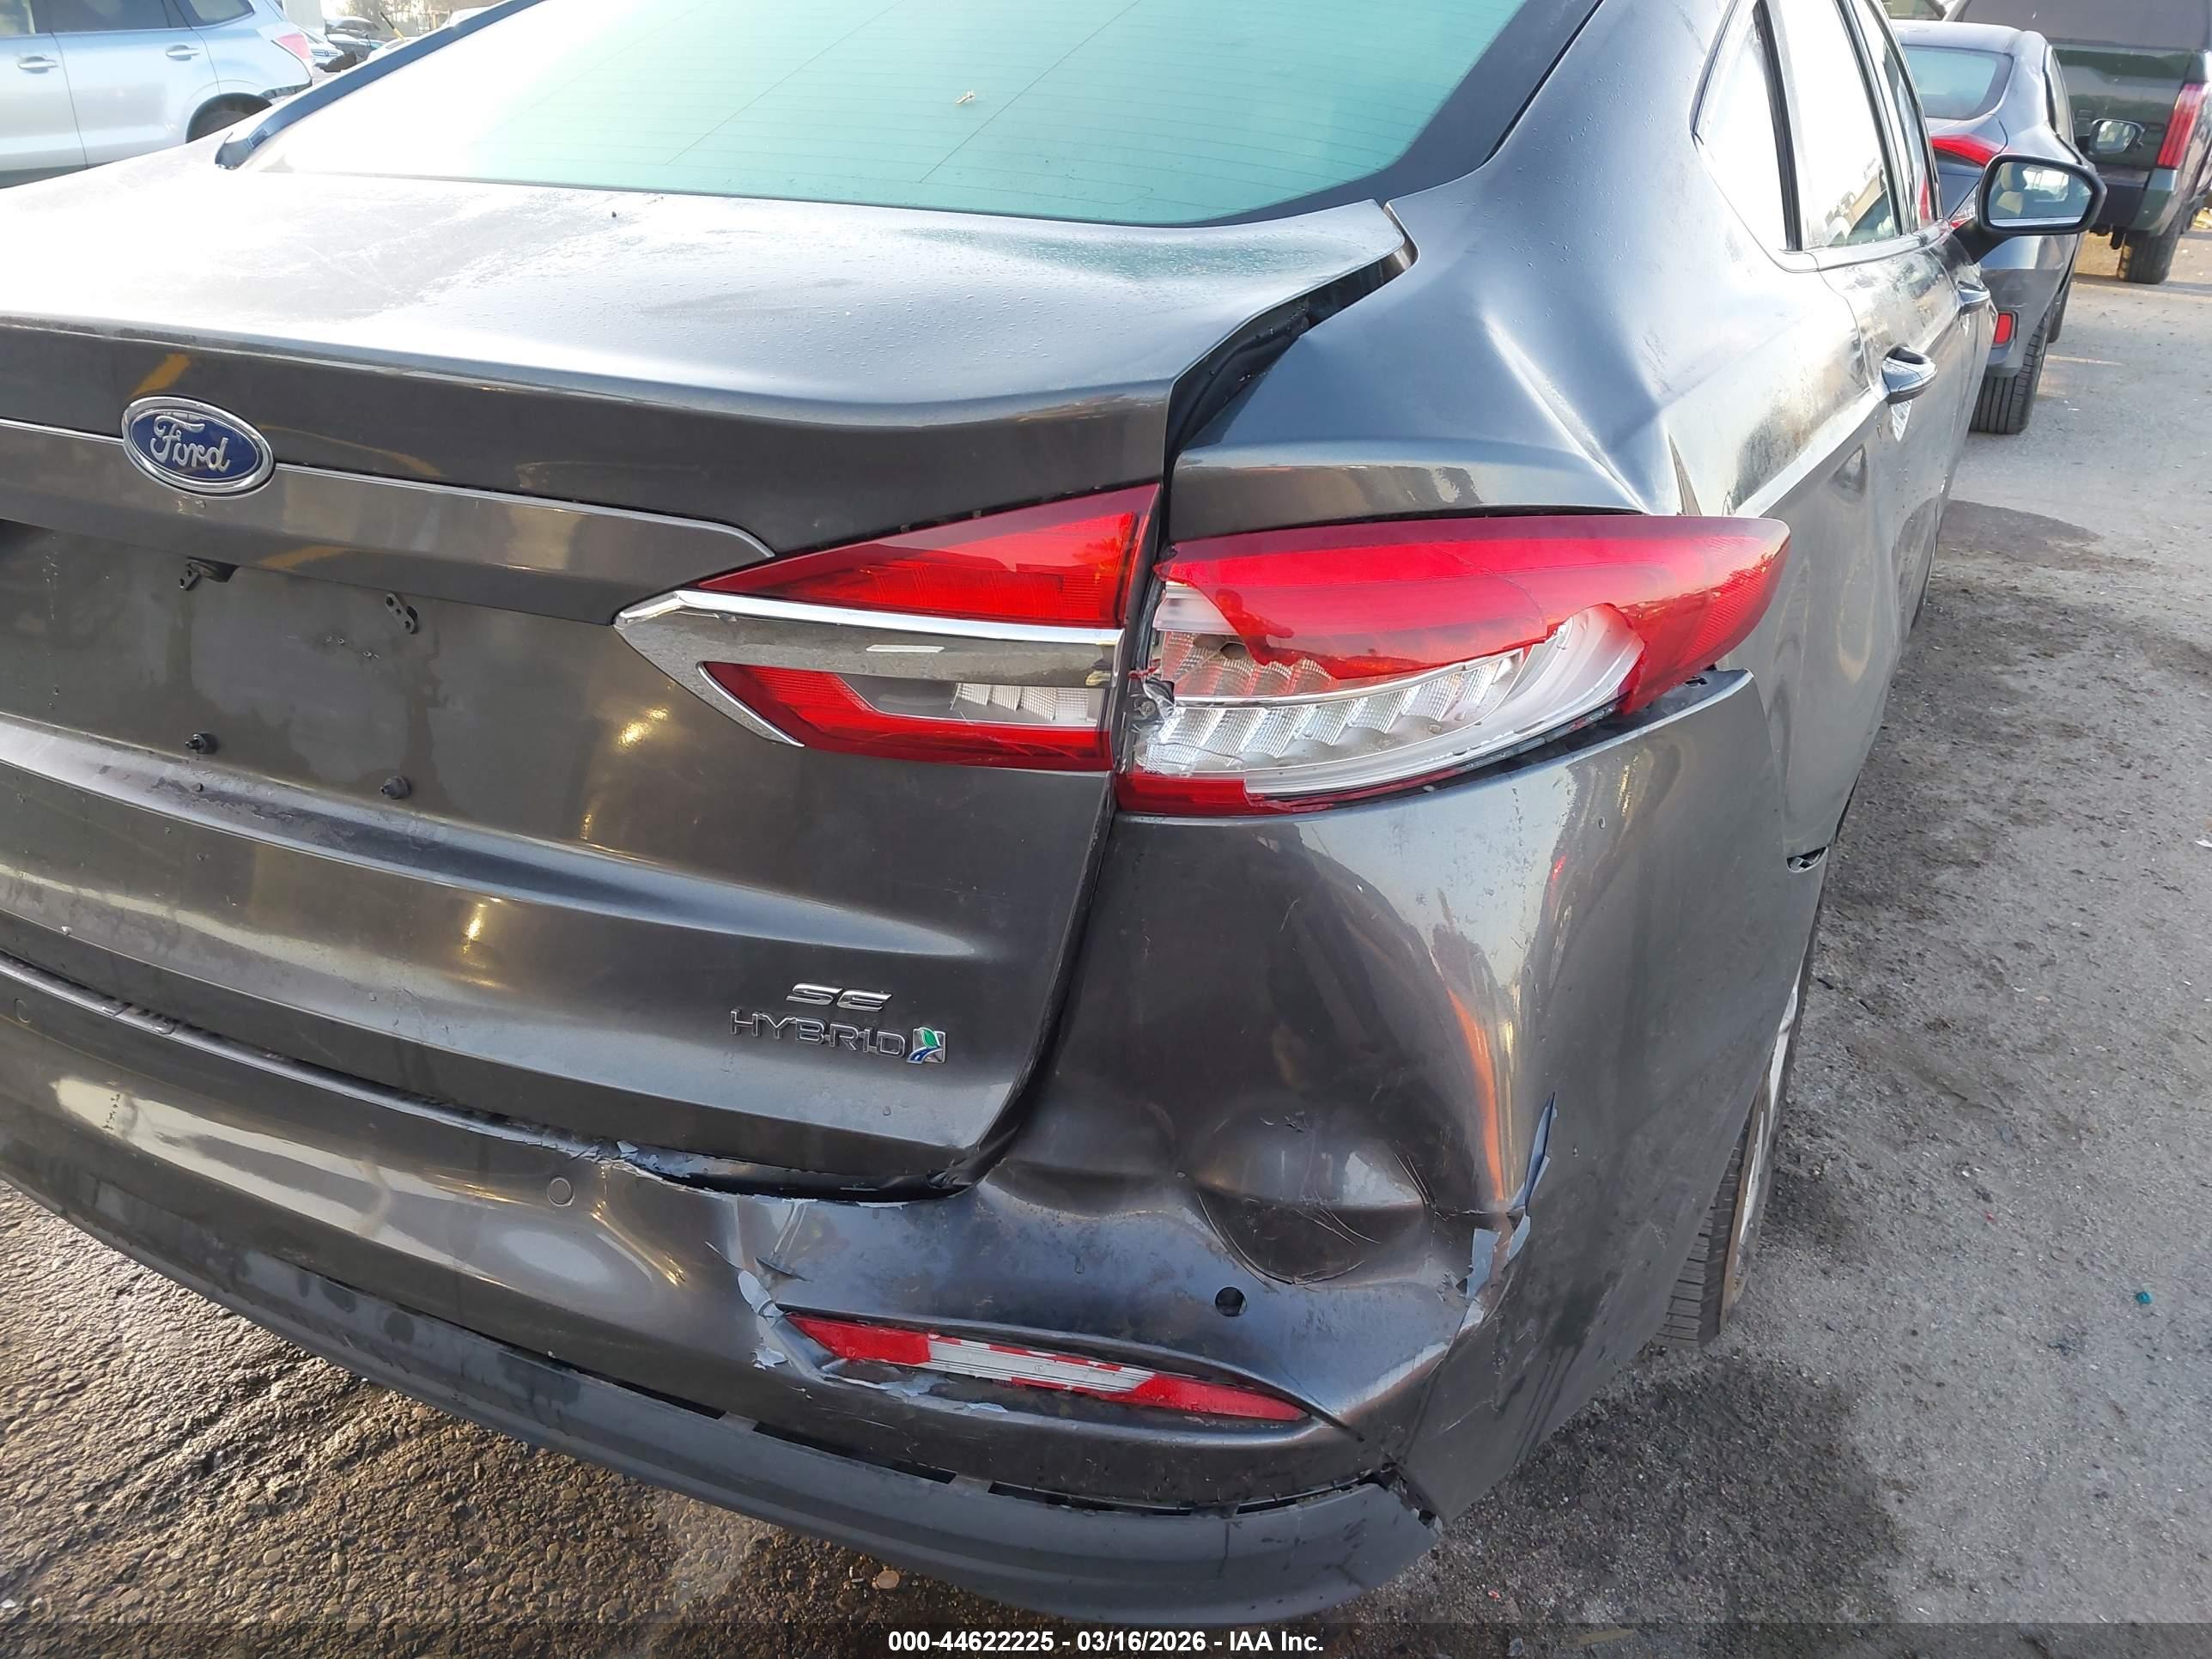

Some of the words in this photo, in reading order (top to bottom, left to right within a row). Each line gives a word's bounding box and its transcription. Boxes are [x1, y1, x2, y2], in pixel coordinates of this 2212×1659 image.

[150, 414, 230, 472] Ford
[787, 982, 893, 1012] SE
[730, 1008, 907, 1058] HYBRID
